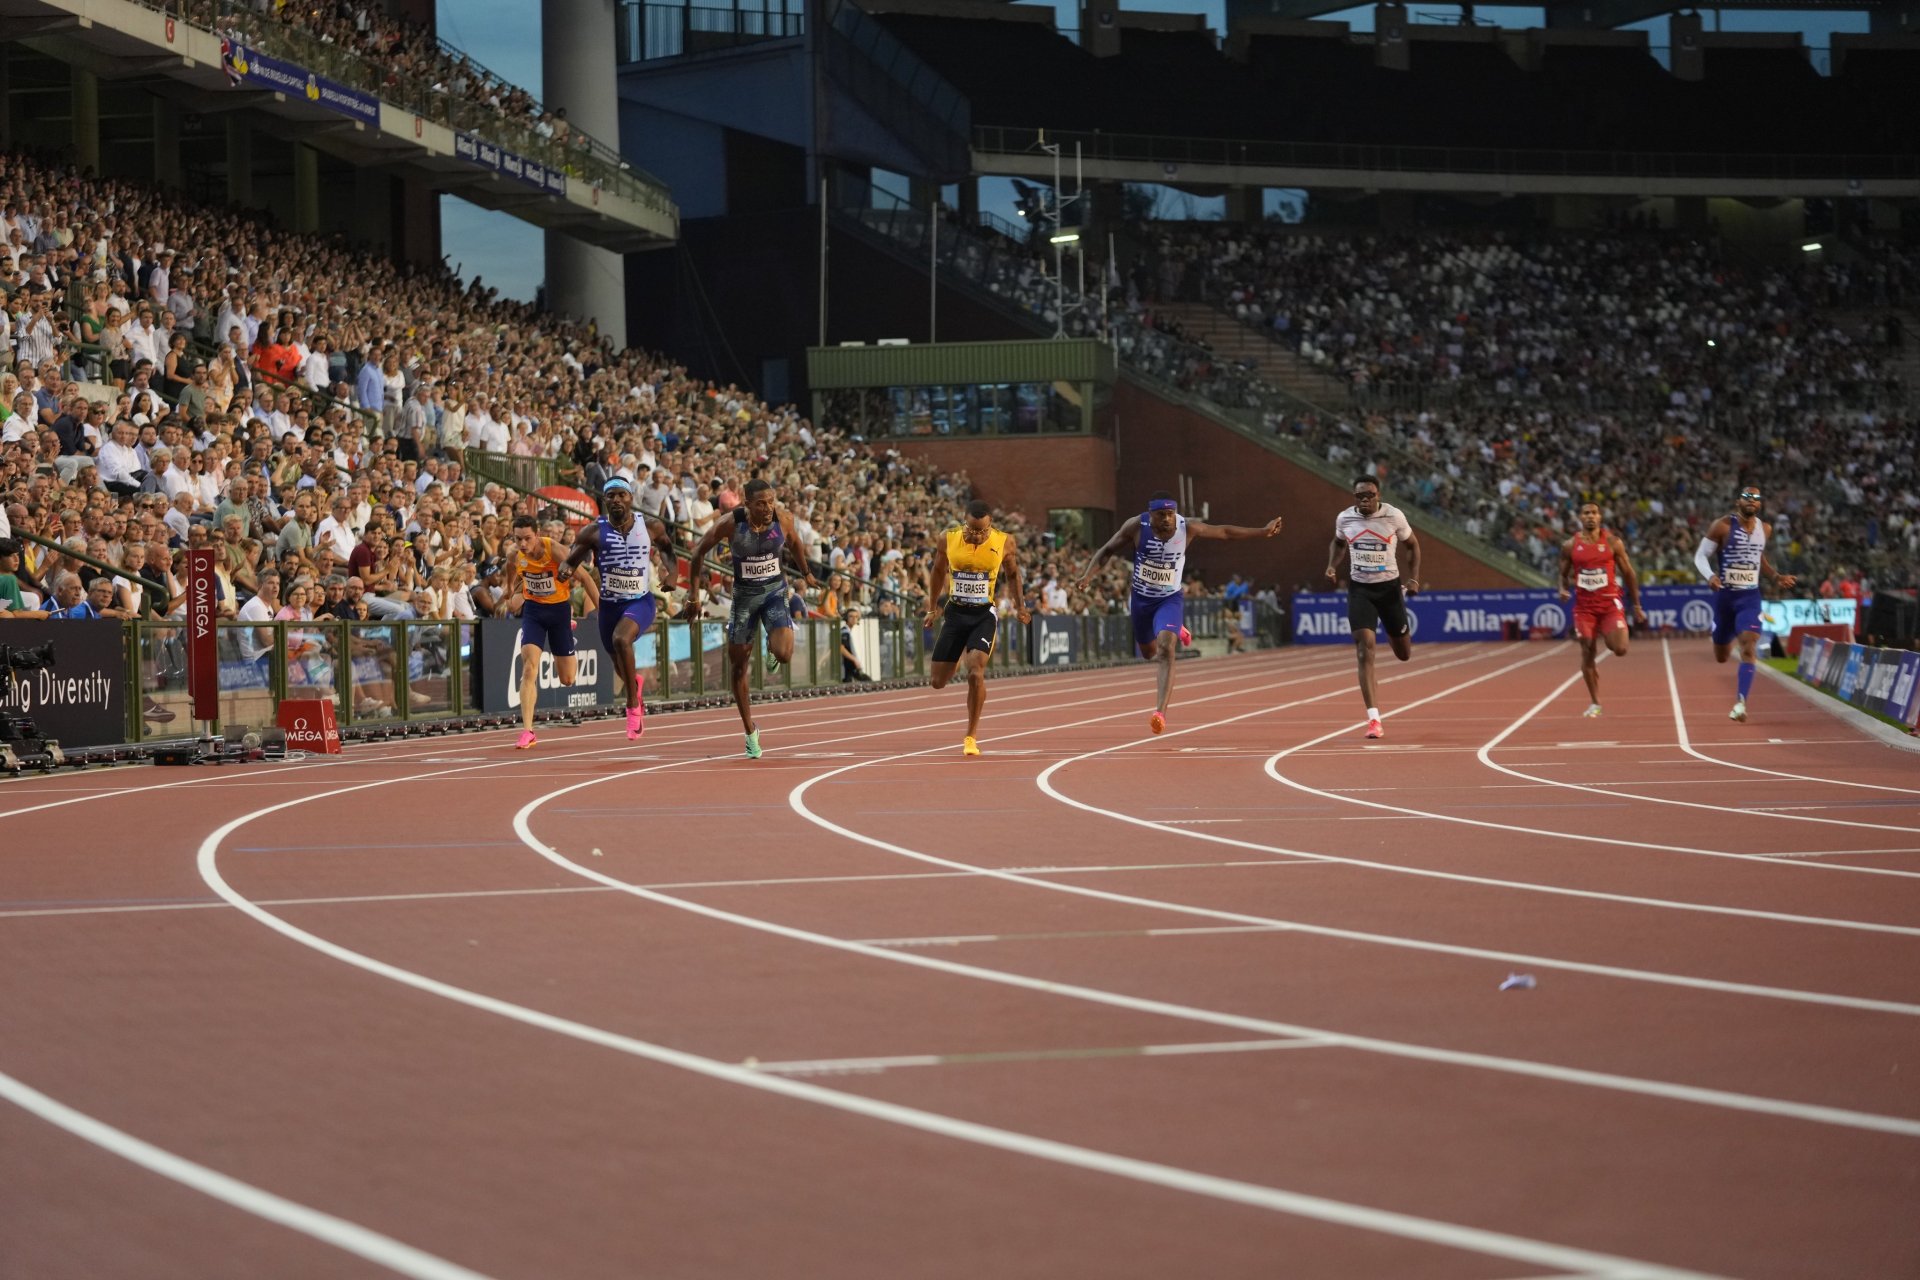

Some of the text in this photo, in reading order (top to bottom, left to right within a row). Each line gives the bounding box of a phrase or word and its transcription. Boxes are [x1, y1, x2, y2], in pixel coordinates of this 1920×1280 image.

[611, 567, 631, 576] Allianz
[745, 562, 776, 575] HUGHES
[1142, 567, 1171, 581] BROWN
[1729, 572, 1754, 582] KING
[527, 580, 552, 590] TORTU
[608, 578, 640, 590] BEDNAREK
[955, 582, 986, 594] DE GRASSE
[195, 578, 208, 639] OMEGA
[0, 667, 111, 713] ing Diversity
[285, 731, 323, 741] MEGA
